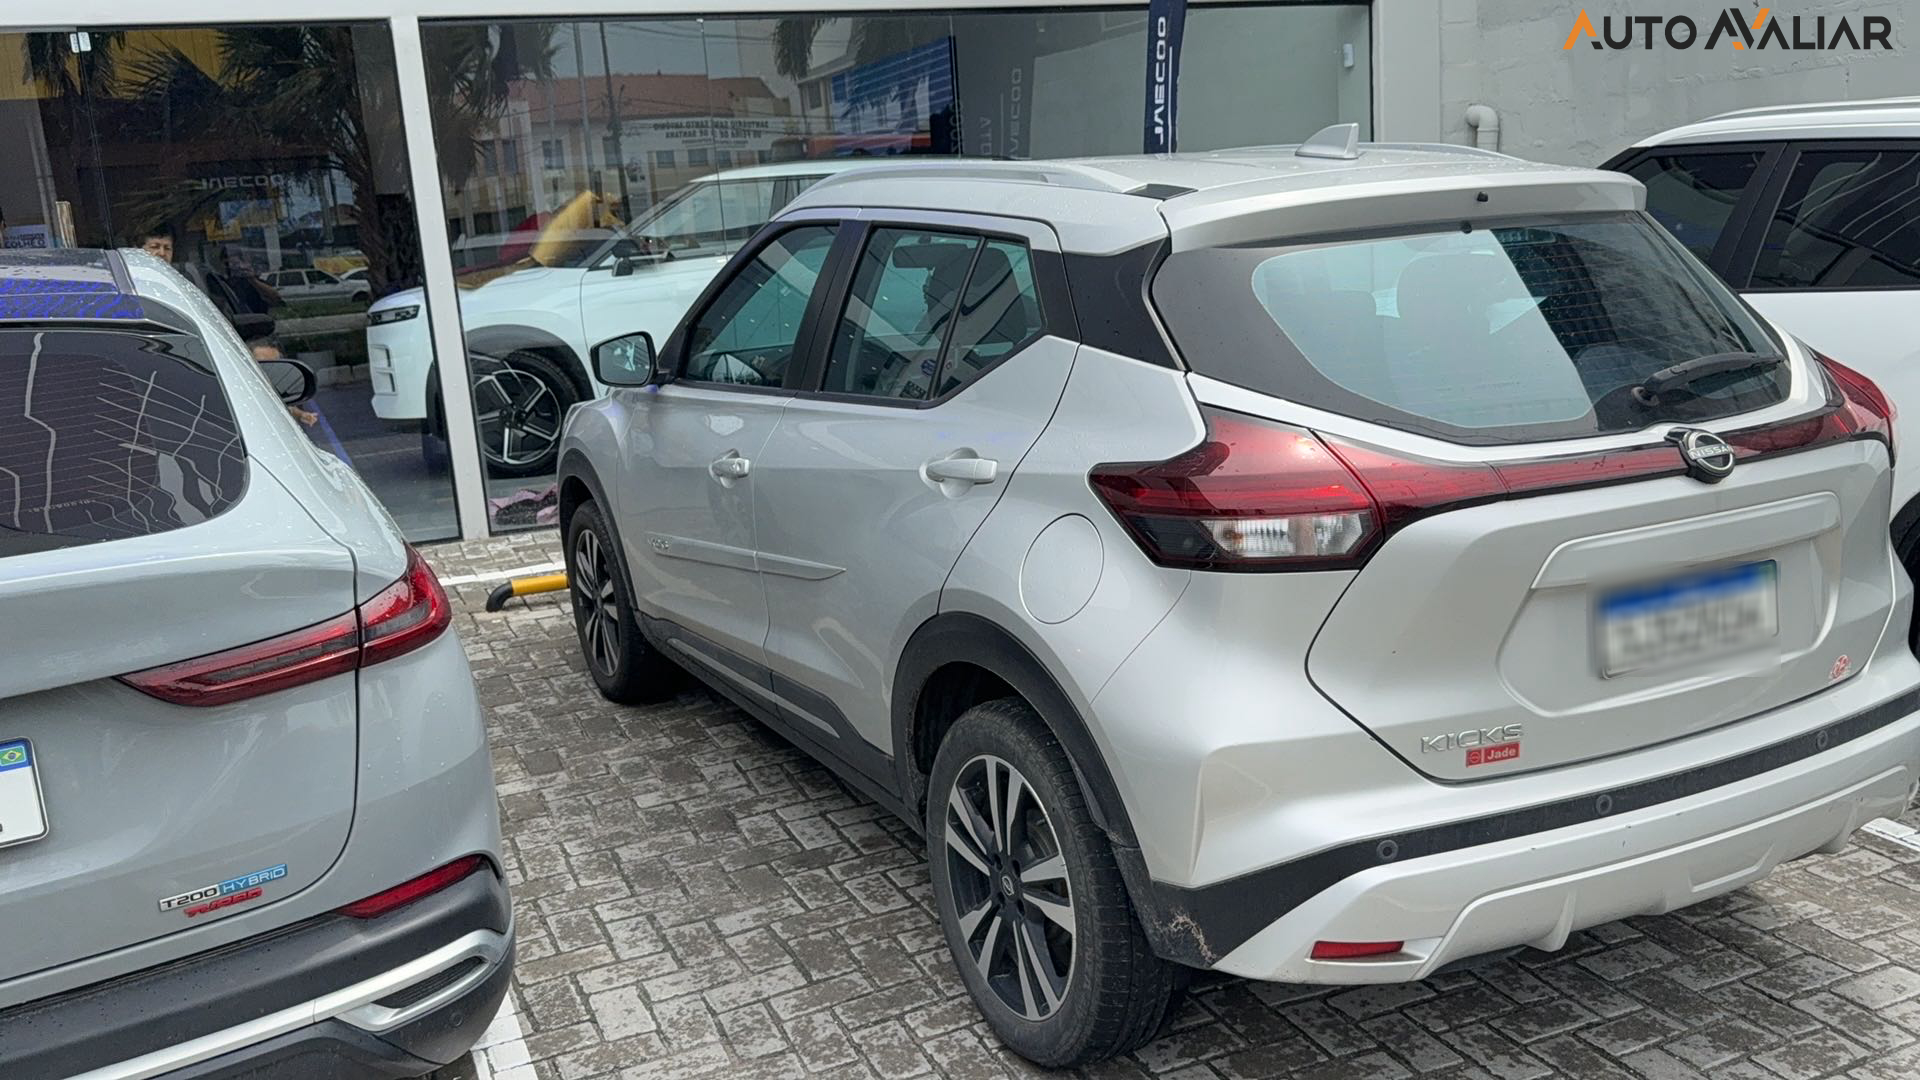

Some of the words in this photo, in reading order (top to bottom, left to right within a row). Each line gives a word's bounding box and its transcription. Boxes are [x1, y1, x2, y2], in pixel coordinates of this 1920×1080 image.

[1153, 15, 1167, 146] JAECOO
[1689, 444, 1735, 460] NISSAN
[1421, 723, 1523, 754] KICKS
[1487, 747, 1517, 761] Jade
[161, 887, 218, 908] T200
[222, 867, 285, 893] HYBRID
